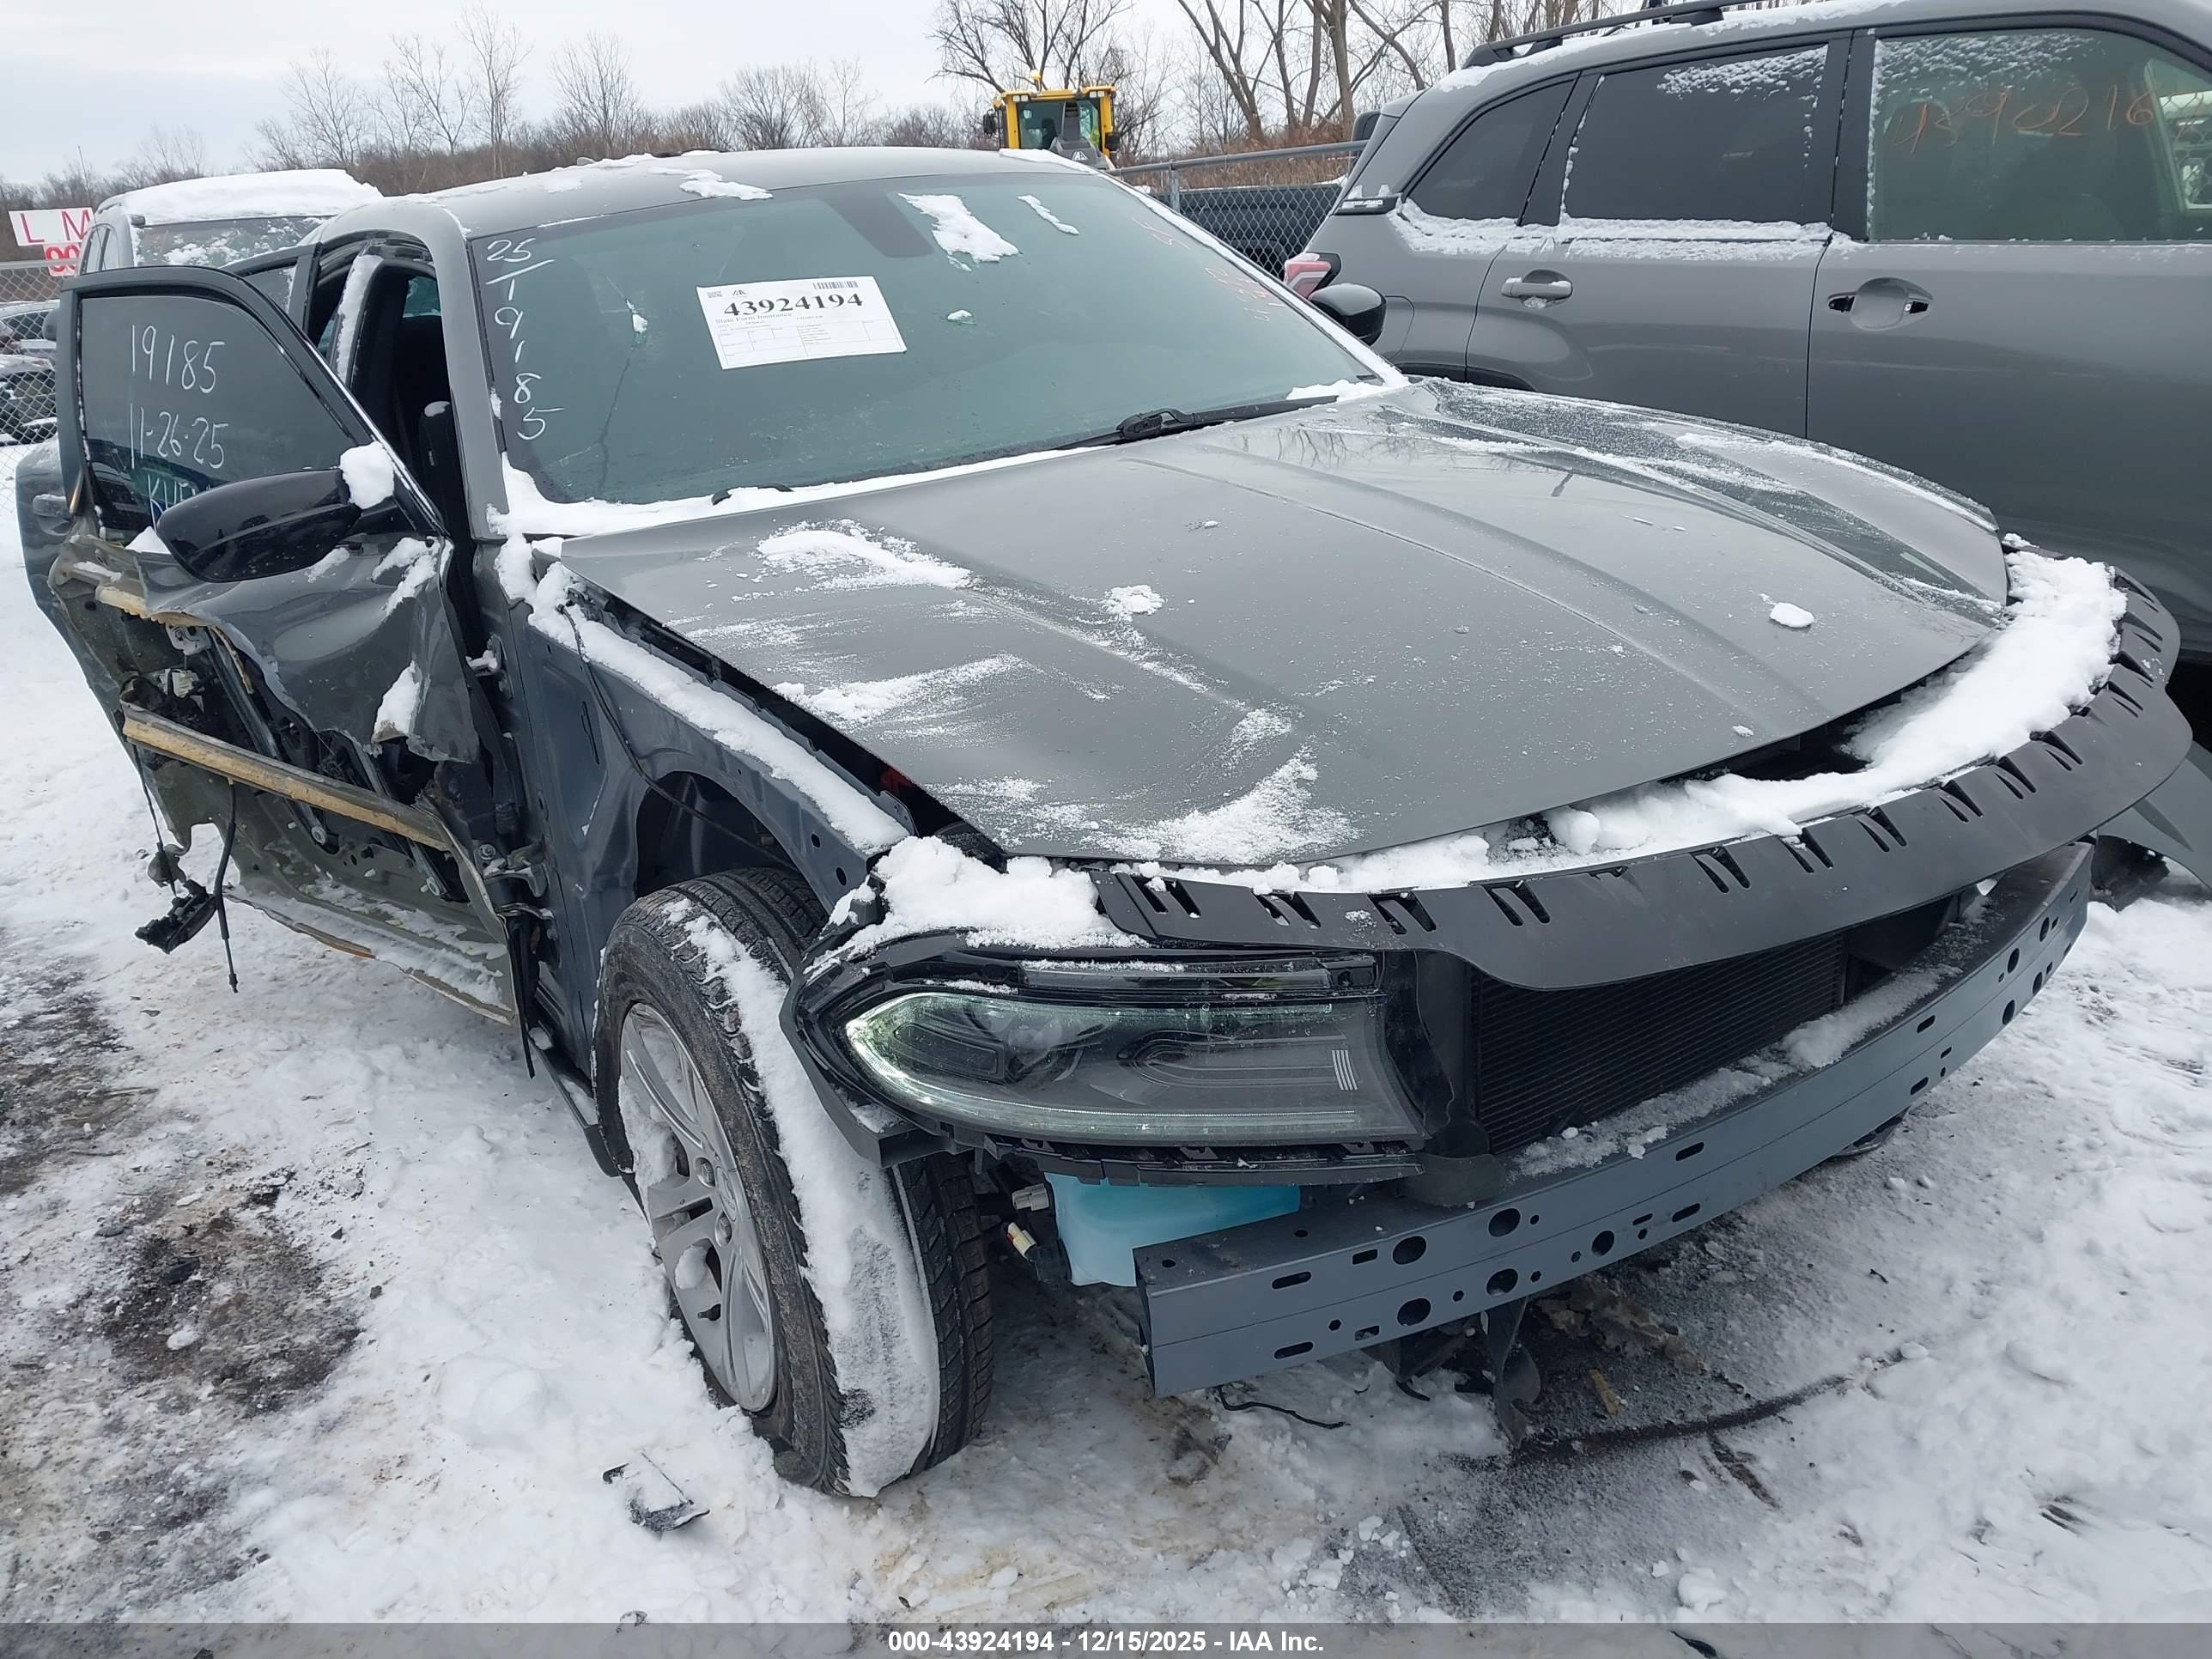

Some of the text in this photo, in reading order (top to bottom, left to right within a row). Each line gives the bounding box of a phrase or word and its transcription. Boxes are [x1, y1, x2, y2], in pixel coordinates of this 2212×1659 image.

[20, 210, 90, 243] L M
[486, 238, 537, 262] 25
[724, 293, 863, 317] 43924194
[131, 324, 226, 393] 19185
